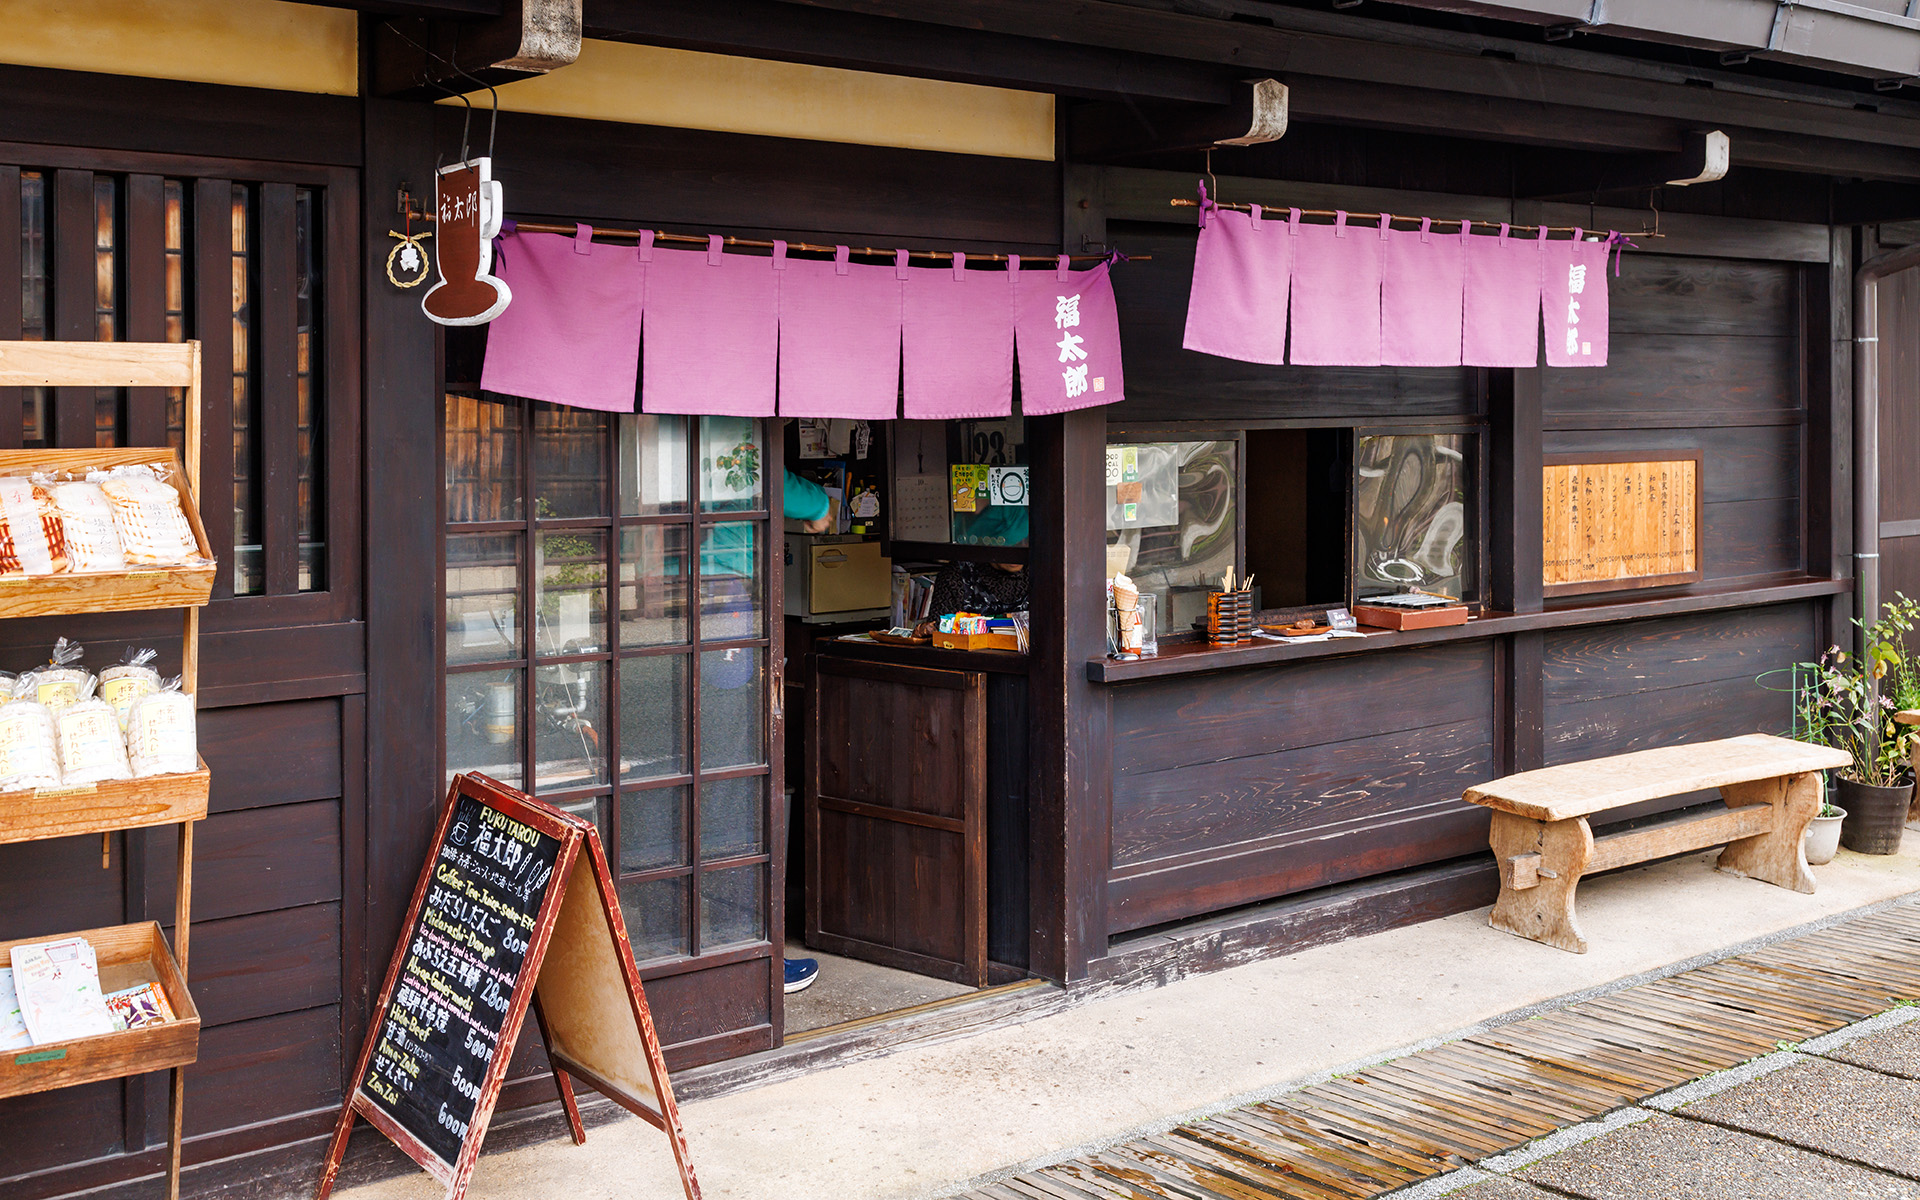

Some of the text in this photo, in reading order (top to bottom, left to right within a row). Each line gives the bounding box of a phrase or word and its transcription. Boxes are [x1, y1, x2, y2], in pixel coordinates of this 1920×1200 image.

[1055, 293, 1088, 398] 福太郎
[470, 822, 523, 871] 福太郎
[480, 806, 540, 847] FUKUTAROU
[464, 1027, 494, 1064] 500円
[375, 1054, 469, 1141] ぜんざい 600円
[452, 1065, 481, 1103] 500円
